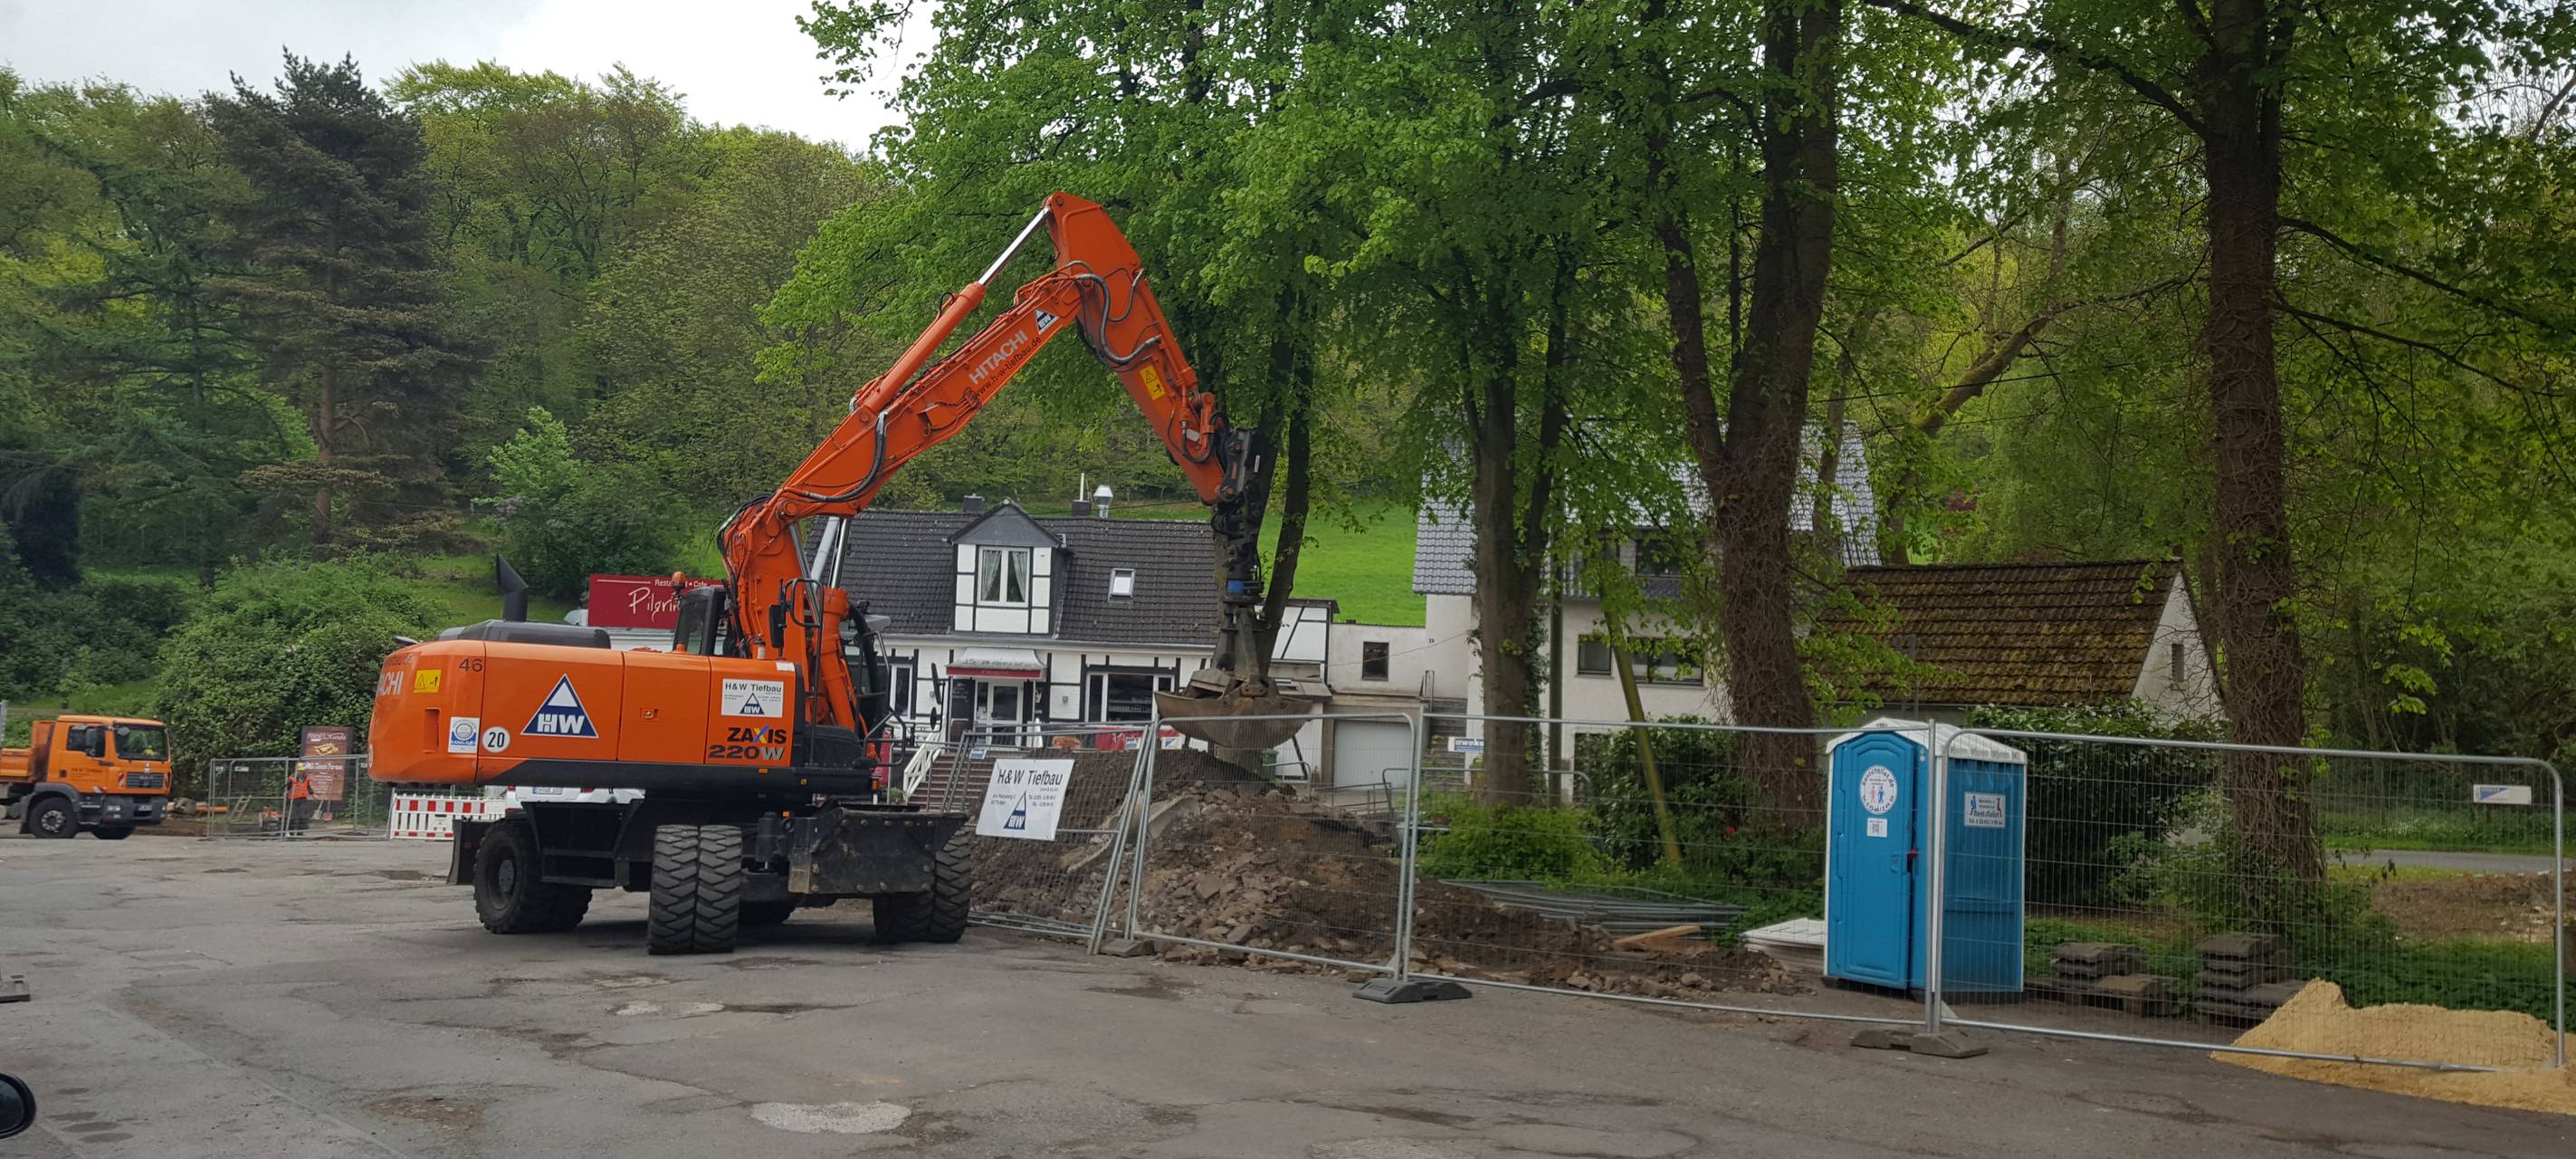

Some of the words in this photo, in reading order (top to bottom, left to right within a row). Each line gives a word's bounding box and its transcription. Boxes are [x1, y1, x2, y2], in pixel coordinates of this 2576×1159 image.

[969, 330, 1028, 385] HITACHI
[459, 658, 483, 672] 46
[751, 684, 781, 693] Tiefbau
[537, 714, 585, 734] HW
[488, 732, 505, 748] 20
[727, 724, 787, 744] ZAXIS
[709, 744, 785, 761] 220W
[1027, 770, 1064, 786] Tiefbau
